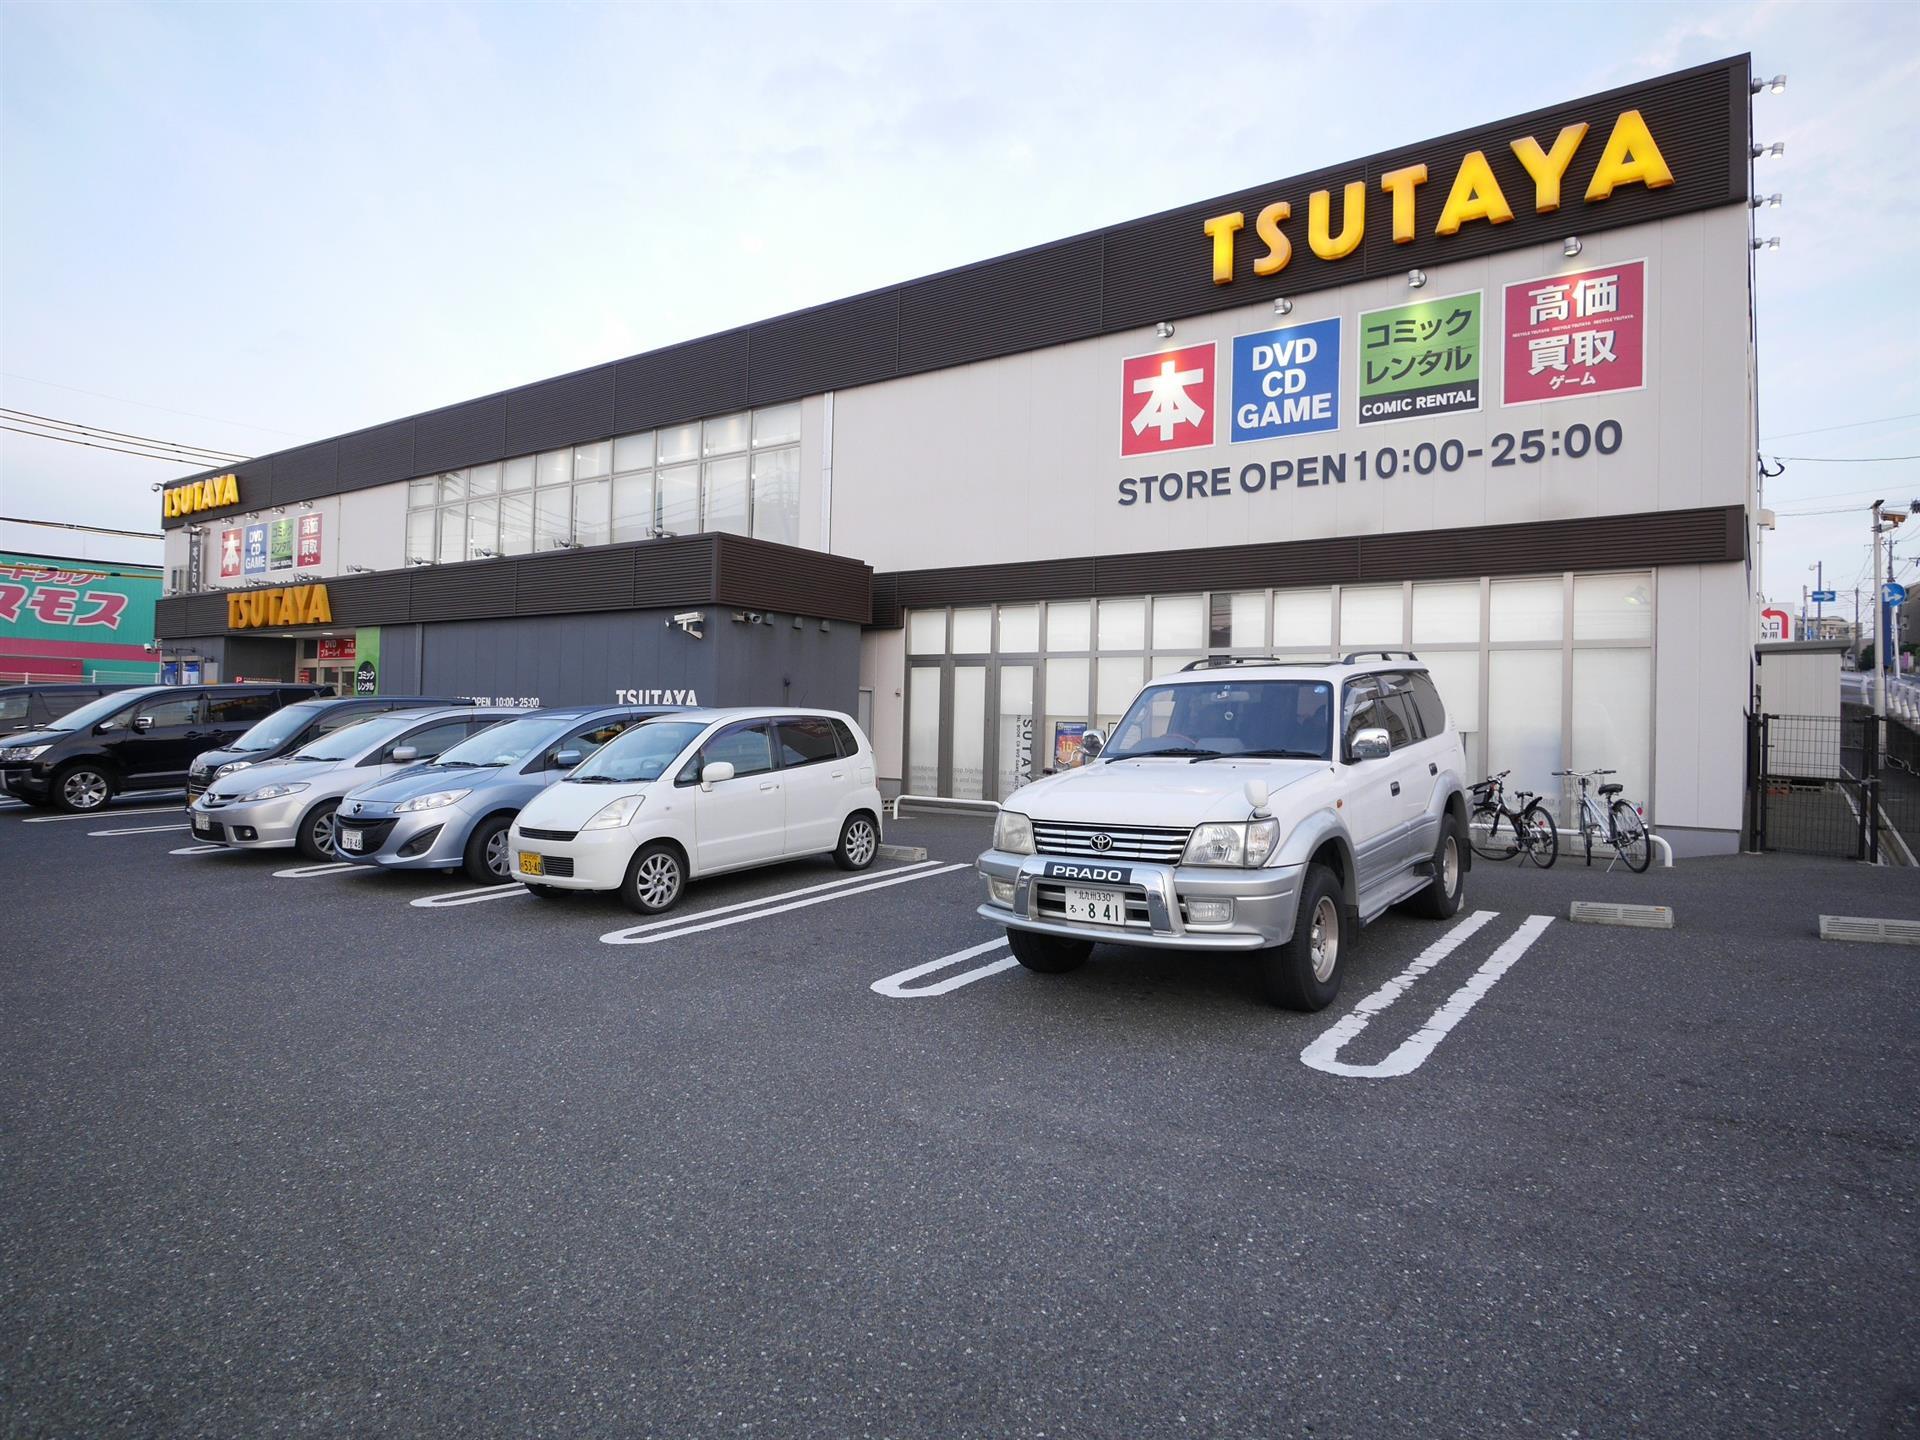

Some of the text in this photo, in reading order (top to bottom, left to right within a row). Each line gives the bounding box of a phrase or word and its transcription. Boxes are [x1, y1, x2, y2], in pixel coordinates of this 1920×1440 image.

[1204, 109, 1675, 285] TSUTAYA
[1527, 274, 1619, 325] 高価
[1366, 308, 1472, 349] コミック
[1252, 338, 1317, 371] DVD
[1366, 345, 1473, 385] レンタル
[1527, 330, 1617, 375] 買取
[1262, 368, 1306, 398] CD
[1549, 372, 1597, 390] ゲーム
[1131, 360, 1205, 441] 本
[1237, 392, 1332, 429] GAME
[1362, 389, 1476, 416] COMIC RENTAL
[164, 473, 240, 518] TSUTAYA
[1118, 467, 1231, 506] STORE
[1240, 453, 1346, 494] OPEN
[223, 533, 240, 572] 本
[249, 529, 263, 543] DVD
[251, 543, 261, 556] CD
[246, 555, 266, 569] GAME
[226, 584, 333, 629] TSUTAYA
[358, 671, 375, 680] コミック
[358, 682, 375, 691] レンタル
[616, 689, 698, 706] TSUTAYA
[1052, 865, 1122, 881] PRADO
